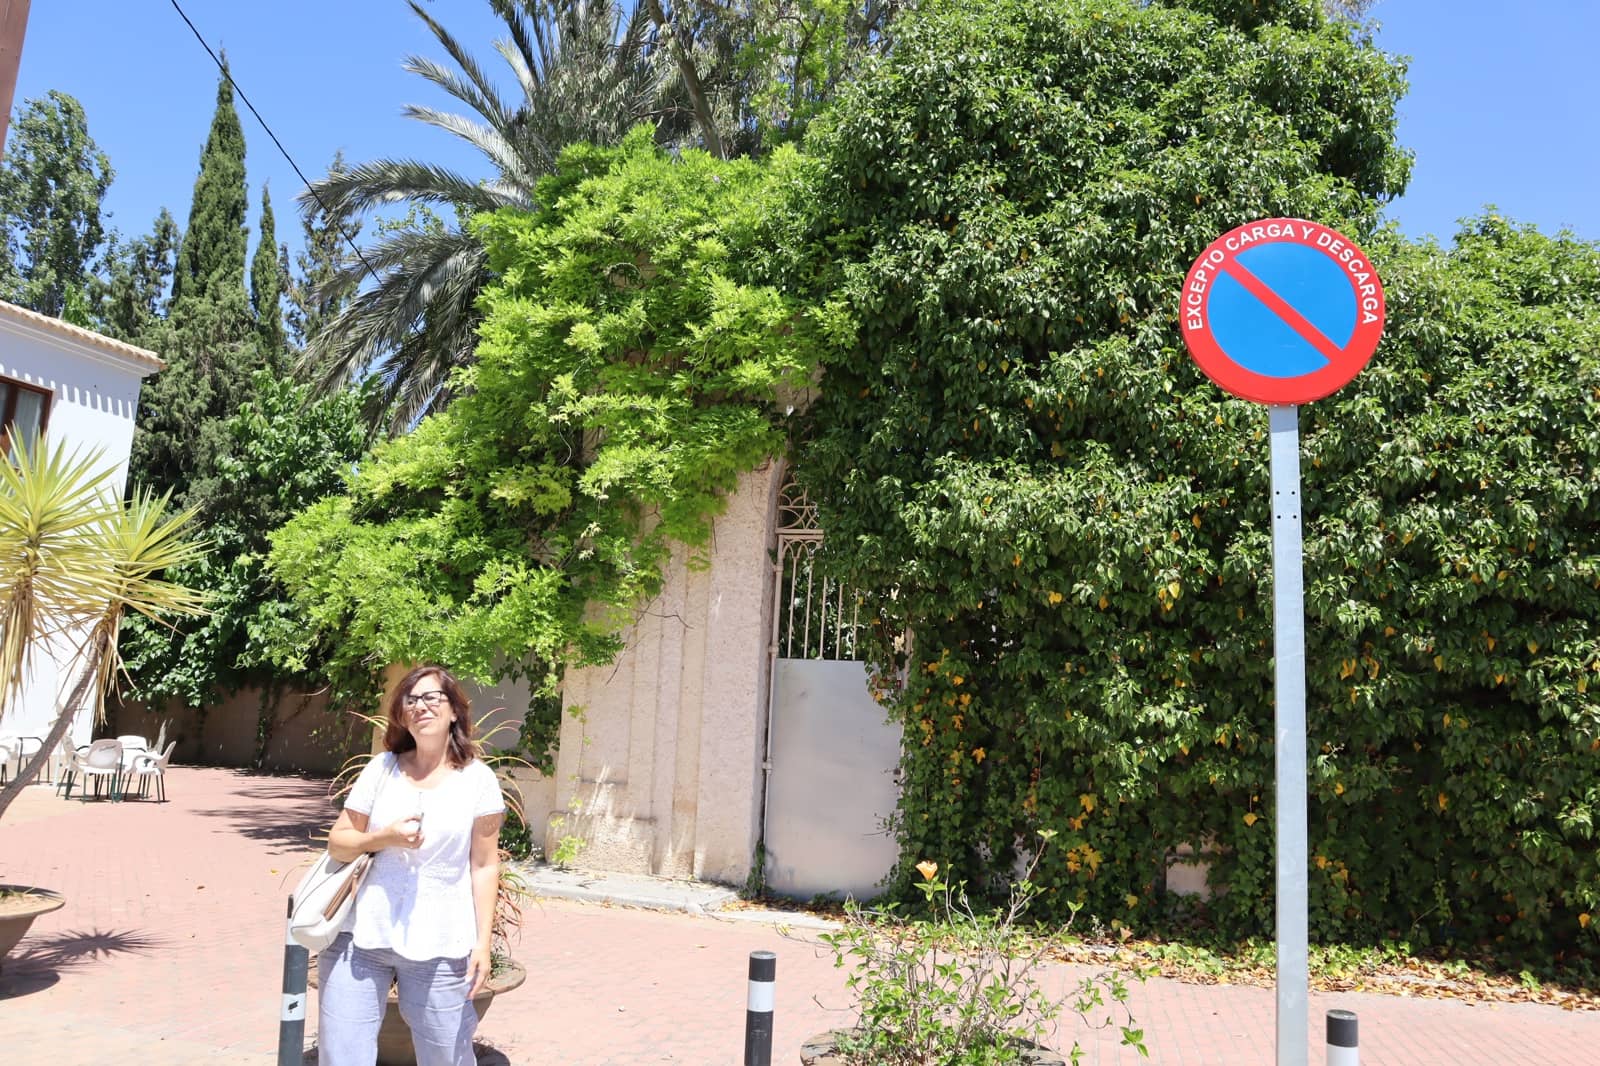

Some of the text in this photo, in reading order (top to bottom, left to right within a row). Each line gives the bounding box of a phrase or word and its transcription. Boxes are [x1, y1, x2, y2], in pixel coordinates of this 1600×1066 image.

[1187, 223, 1378, 330] EXCEPTO CARGA Y DESCARGA
